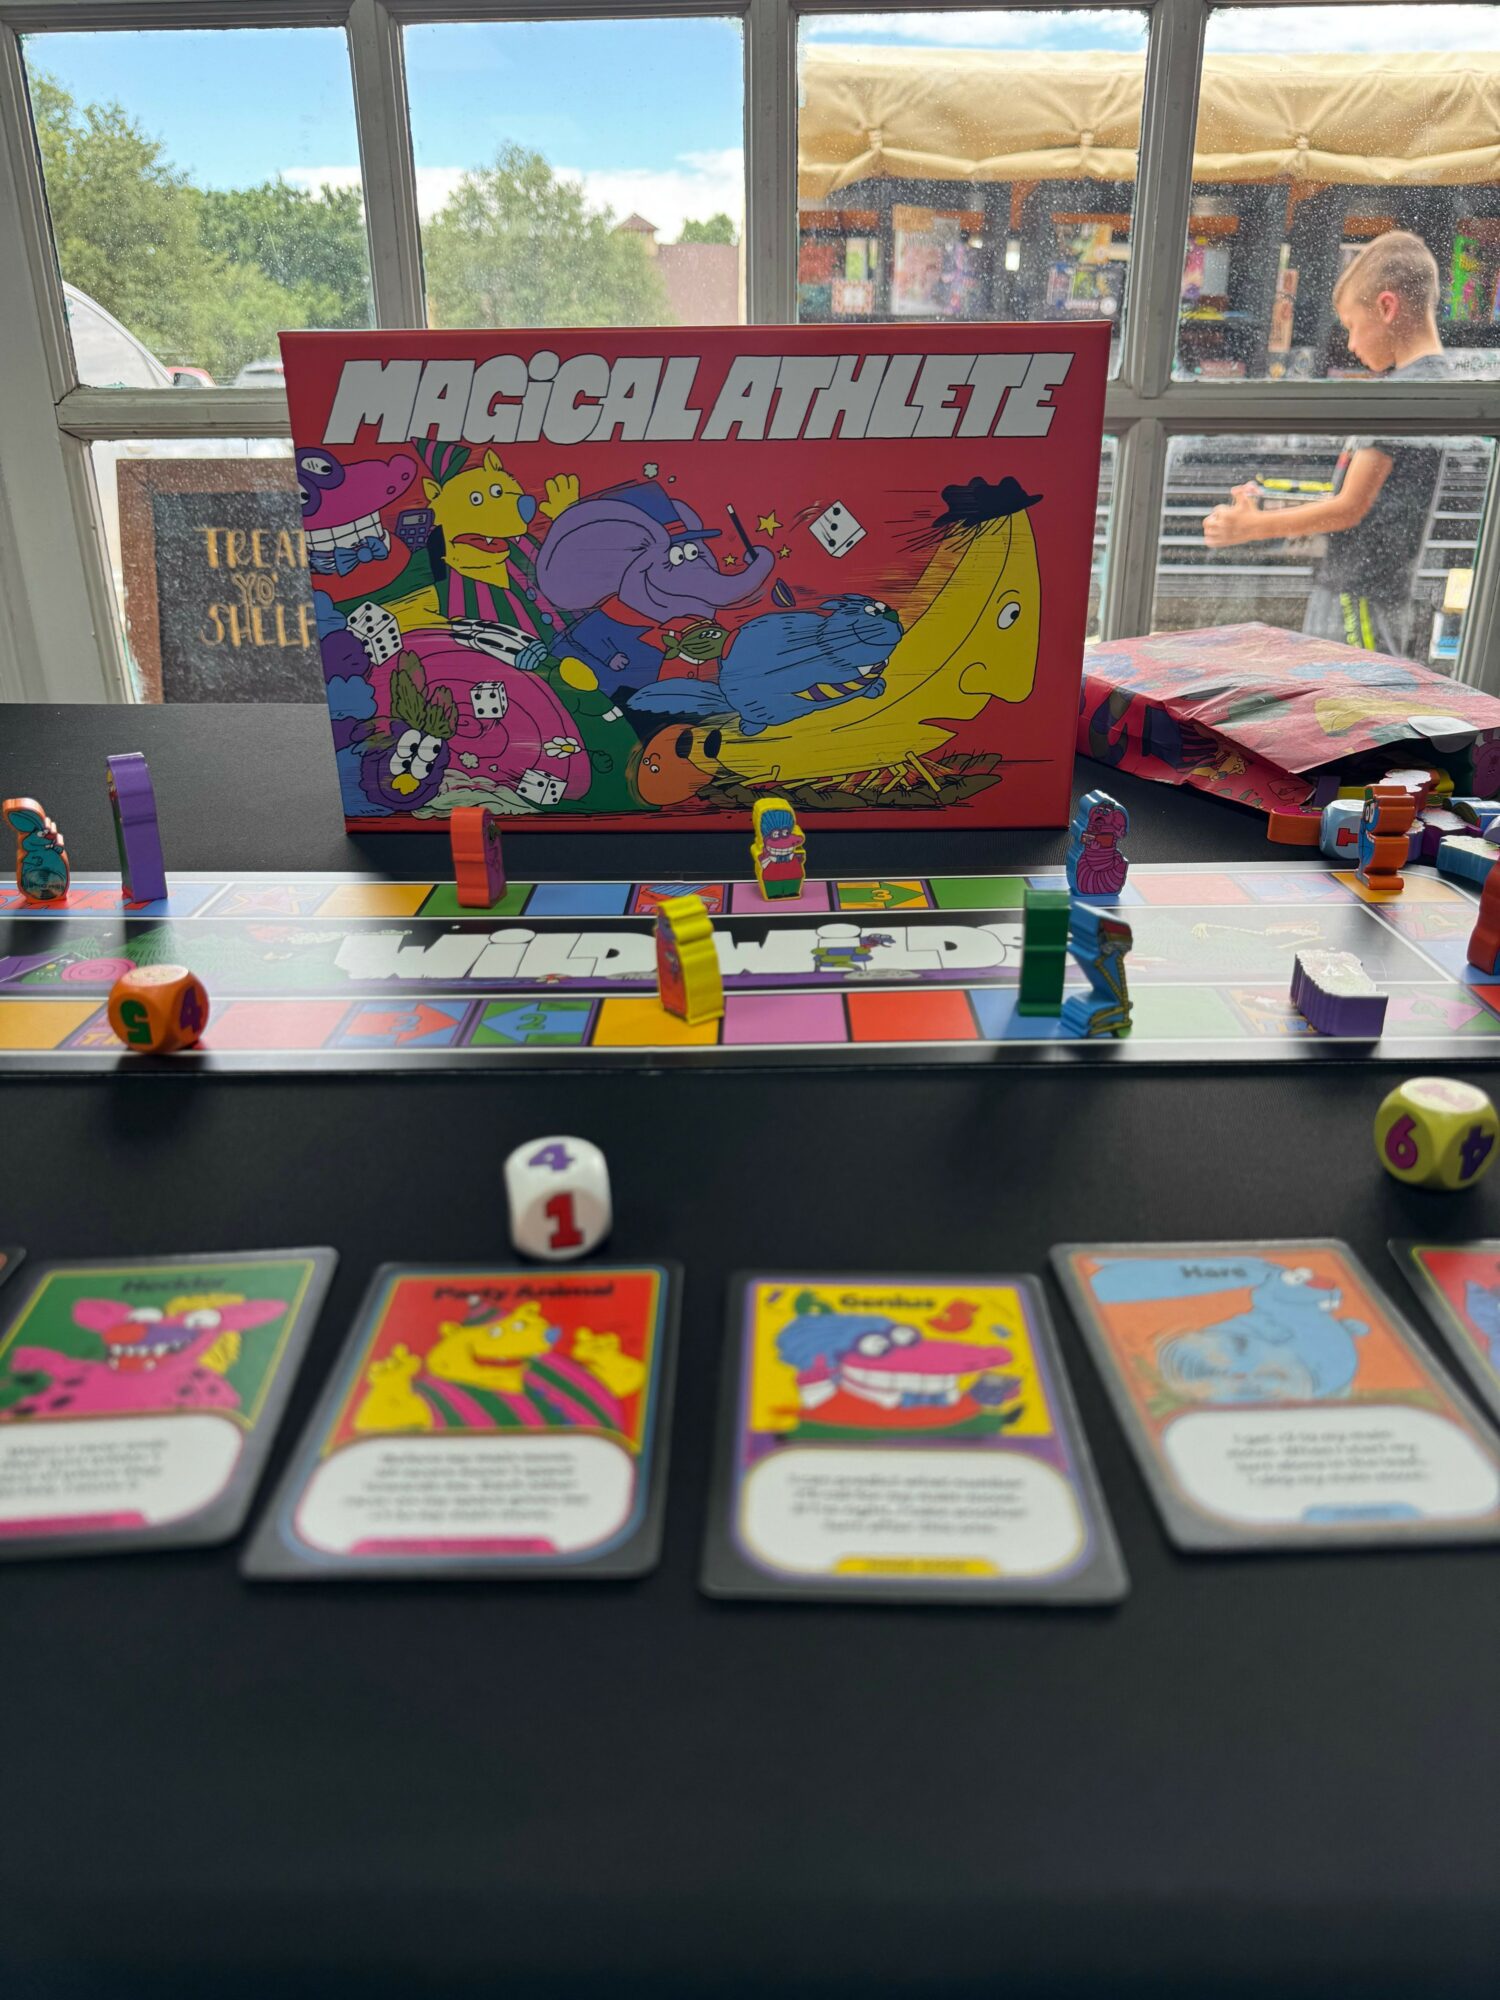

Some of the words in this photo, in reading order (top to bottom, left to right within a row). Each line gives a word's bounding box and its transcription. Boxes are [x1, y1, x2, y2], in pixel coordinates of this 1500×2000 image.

[700, 352, 1075, 441] ATHLETE
[194, 526, 309, 569] TREAT
[200, 602, 317, 648] SHELF
[871, 889, 893, 900] 3
[516, 1013, 548, 1031] 2
[528, 1143, 574, 1171] 4
[1385, 1114, 1418, 1170] 6
[1459, 1125, 1495, 1181] 4
[545, 1190, 584, 1250] 1
[1180, 1264, 1248, 1279] Hare
[515, 1281, 614, 1297] Animal
[840, 1293, 935, 1309] Genius
